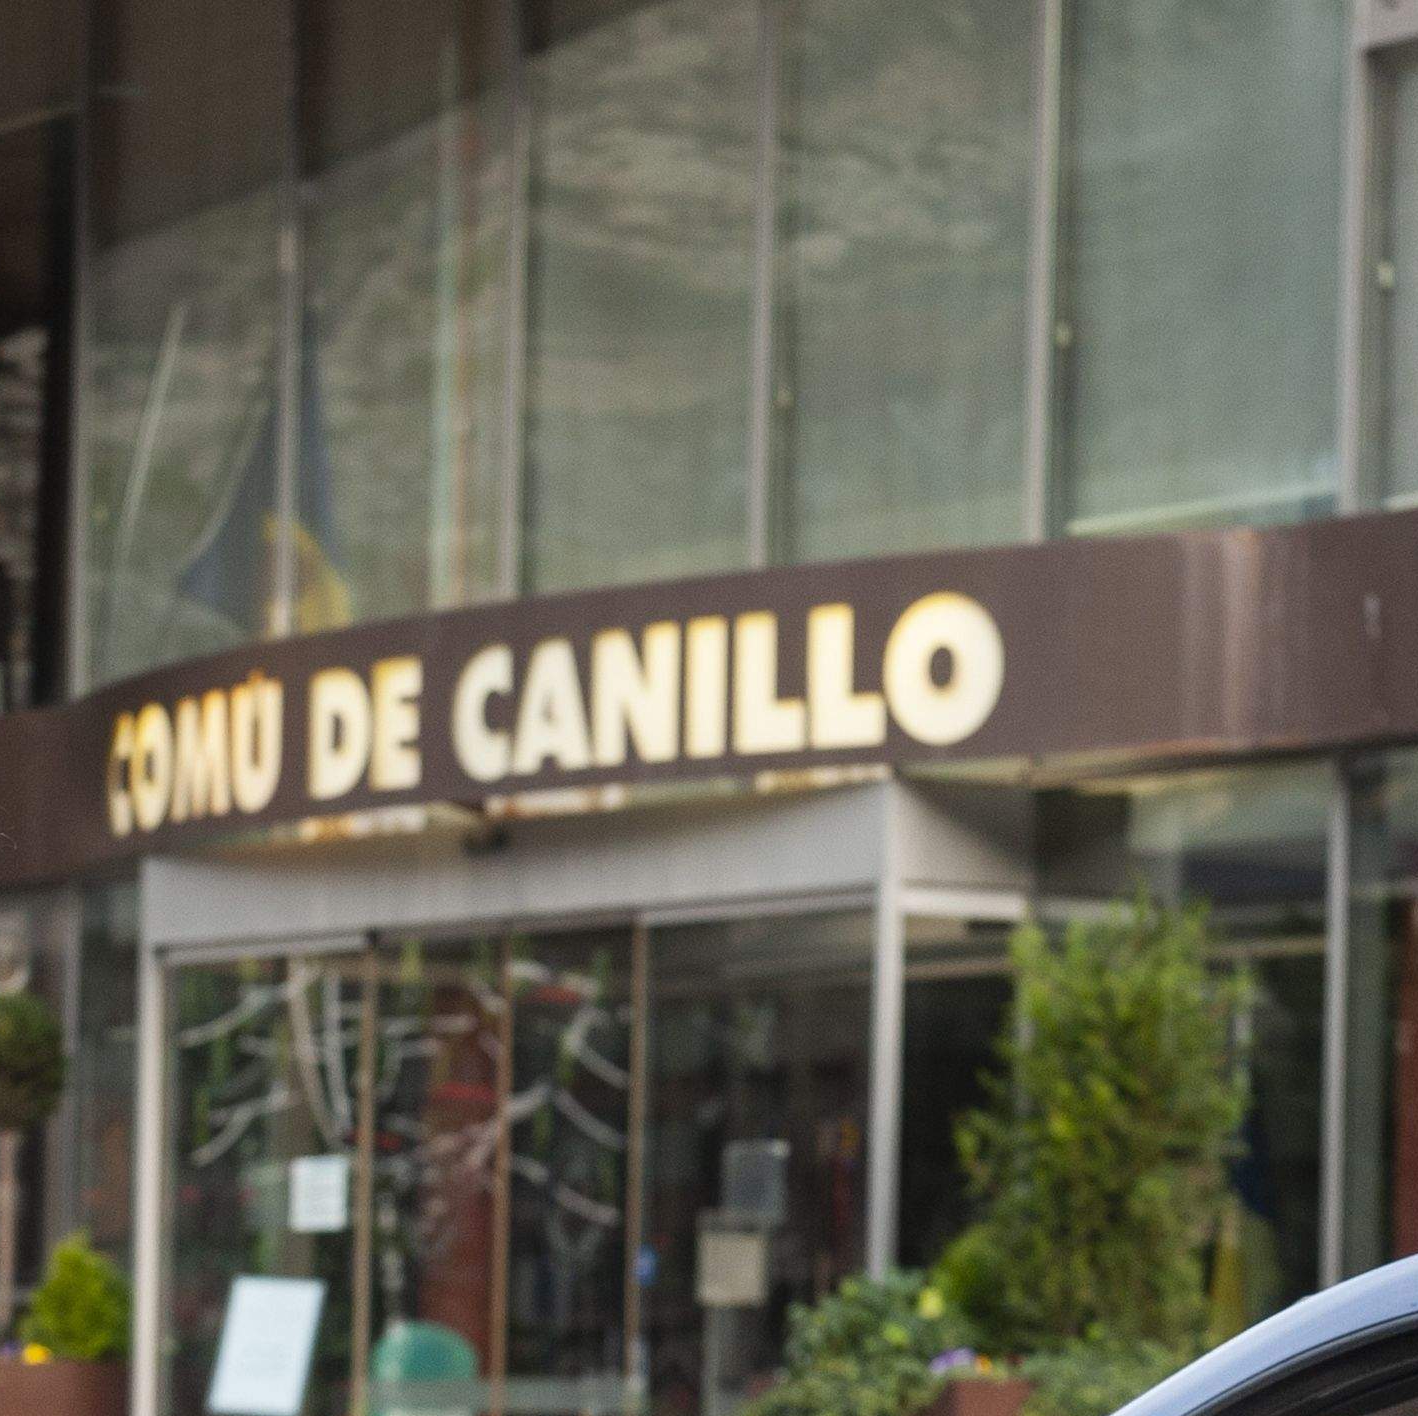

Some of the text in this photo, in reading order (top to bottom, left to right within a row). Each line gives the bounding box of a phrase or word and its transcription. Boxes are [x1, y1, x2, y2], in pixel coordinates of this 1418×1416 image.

[108, 591, 1005, 838] COMÚ DE CANILLO
